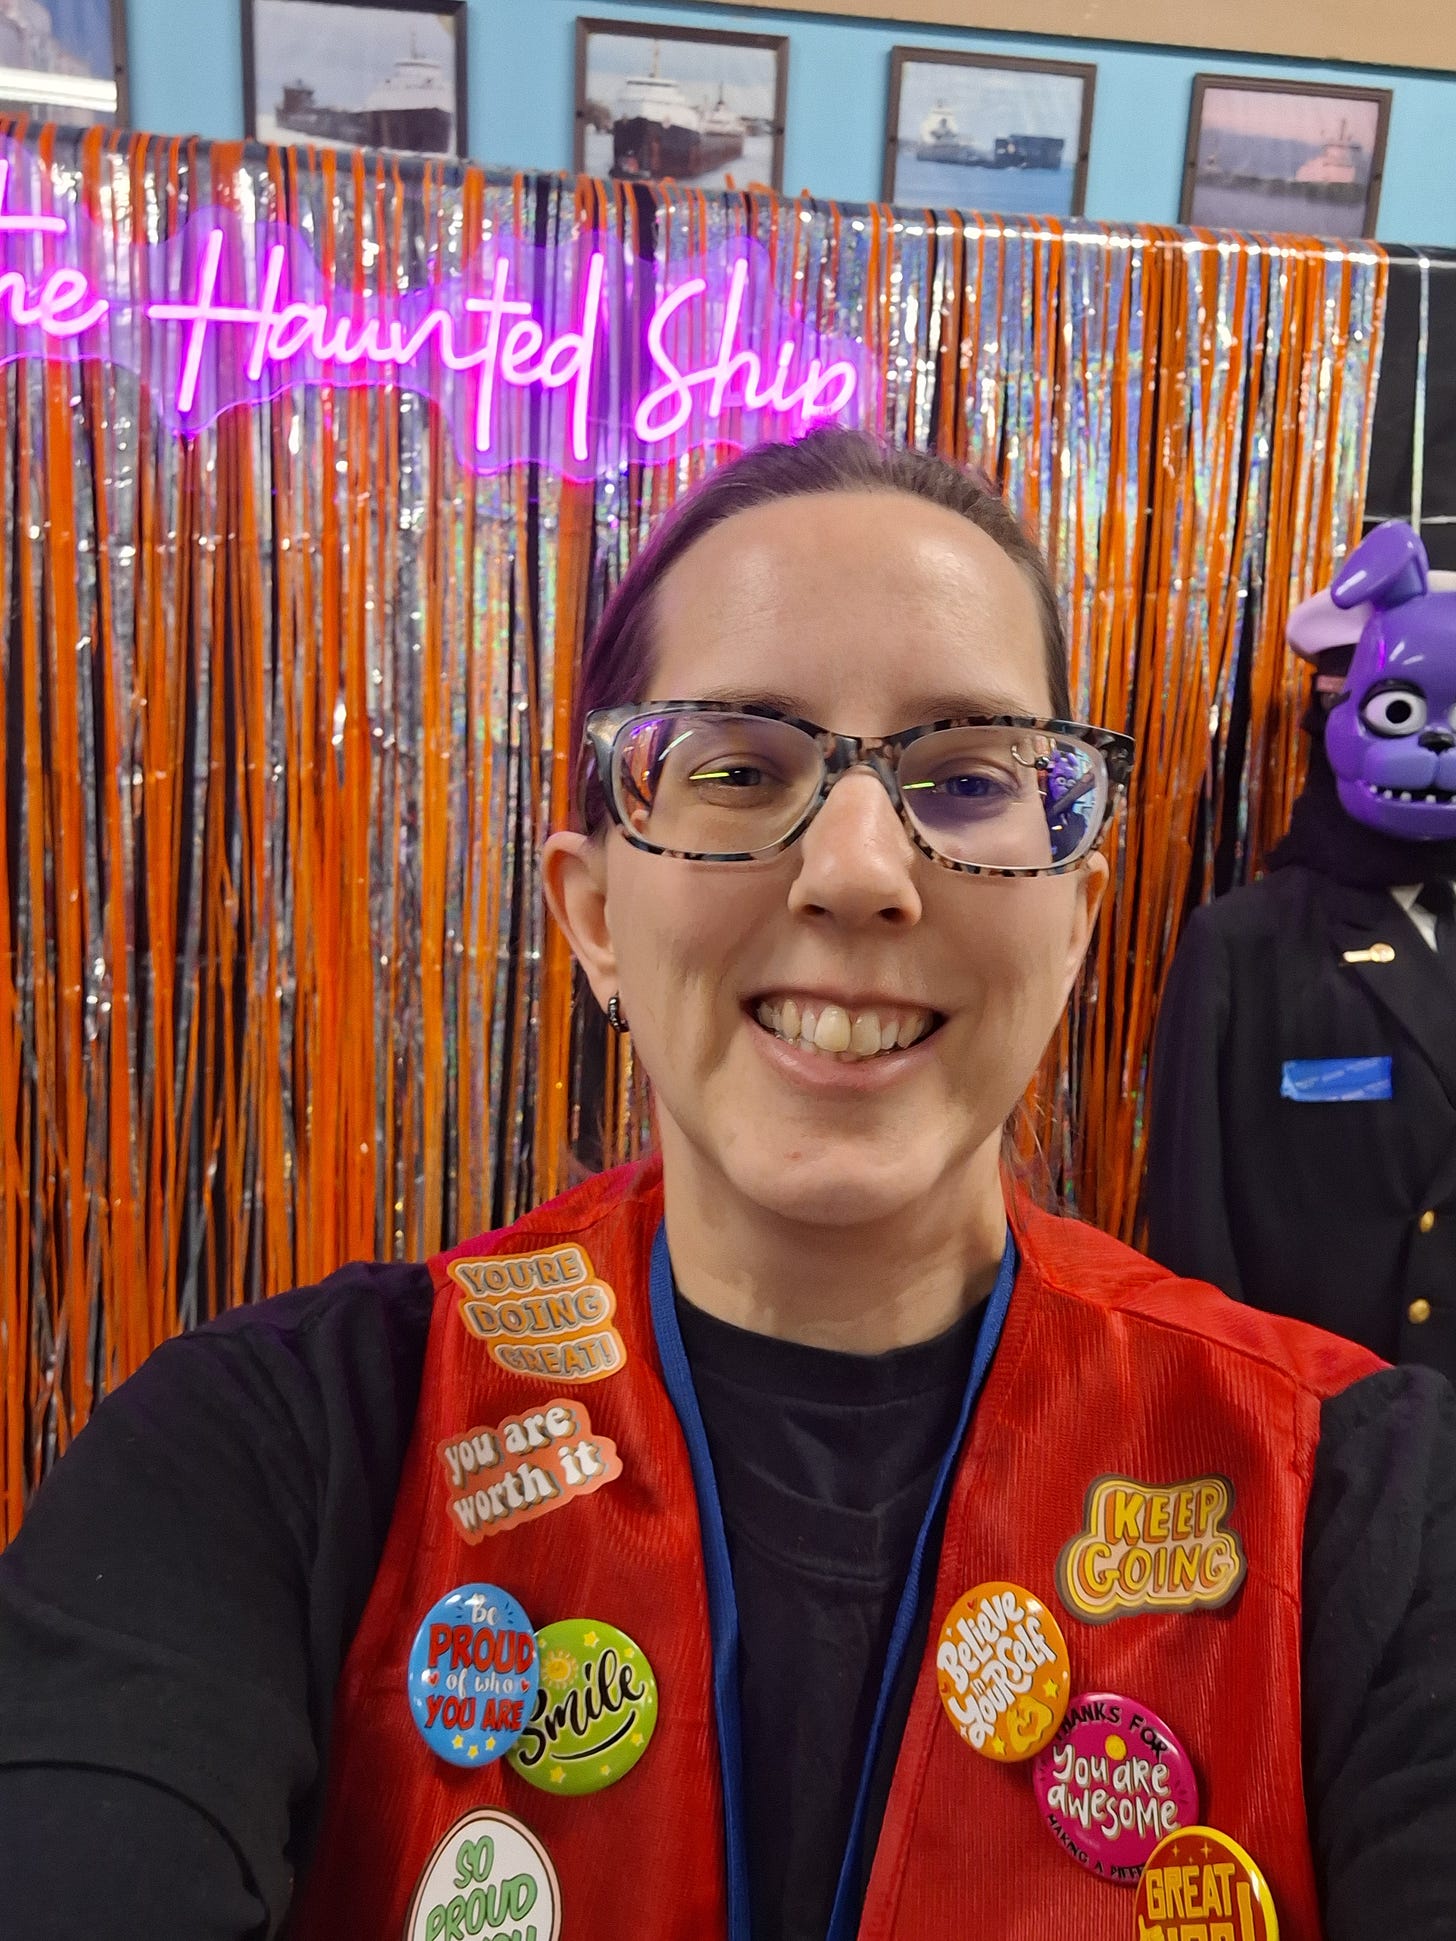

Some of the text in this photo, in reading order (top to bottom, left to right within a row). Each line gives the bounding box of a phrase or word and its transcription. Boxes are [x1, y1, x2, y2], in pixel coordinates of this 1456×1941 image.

[147, 227, 604, 462] Haunted
[633, 257, 858, 443] Ship
[457, 1249, 582, 1295] YOU'RE
[466, 1287, 605, 1334] DOING
[498, 1334, 613, 1375] GREAT!
[444, 1406, 577, 1488] you are
[453, 1440, 606, 1532] worth it
[1104, 1485, 1221, 1546] KEEP
[1077, 1541, 1231, 1598] GOING
[427, 1623, 535, 1674] PROUD
[445, 1667, 514, 1699] of who
[519, 1648, 645, 1766] Smile
[970, 1678, 987, 1696] in
[424, 1694, 524, 1731] YOU ARE
[1129, 1713, 1168, 1760] FOR
[453, 1835, 495, 1889] SO
[425, 1873, 538, 1941] PROUD
[1145, 1862, 1236, 1920] GREAT
